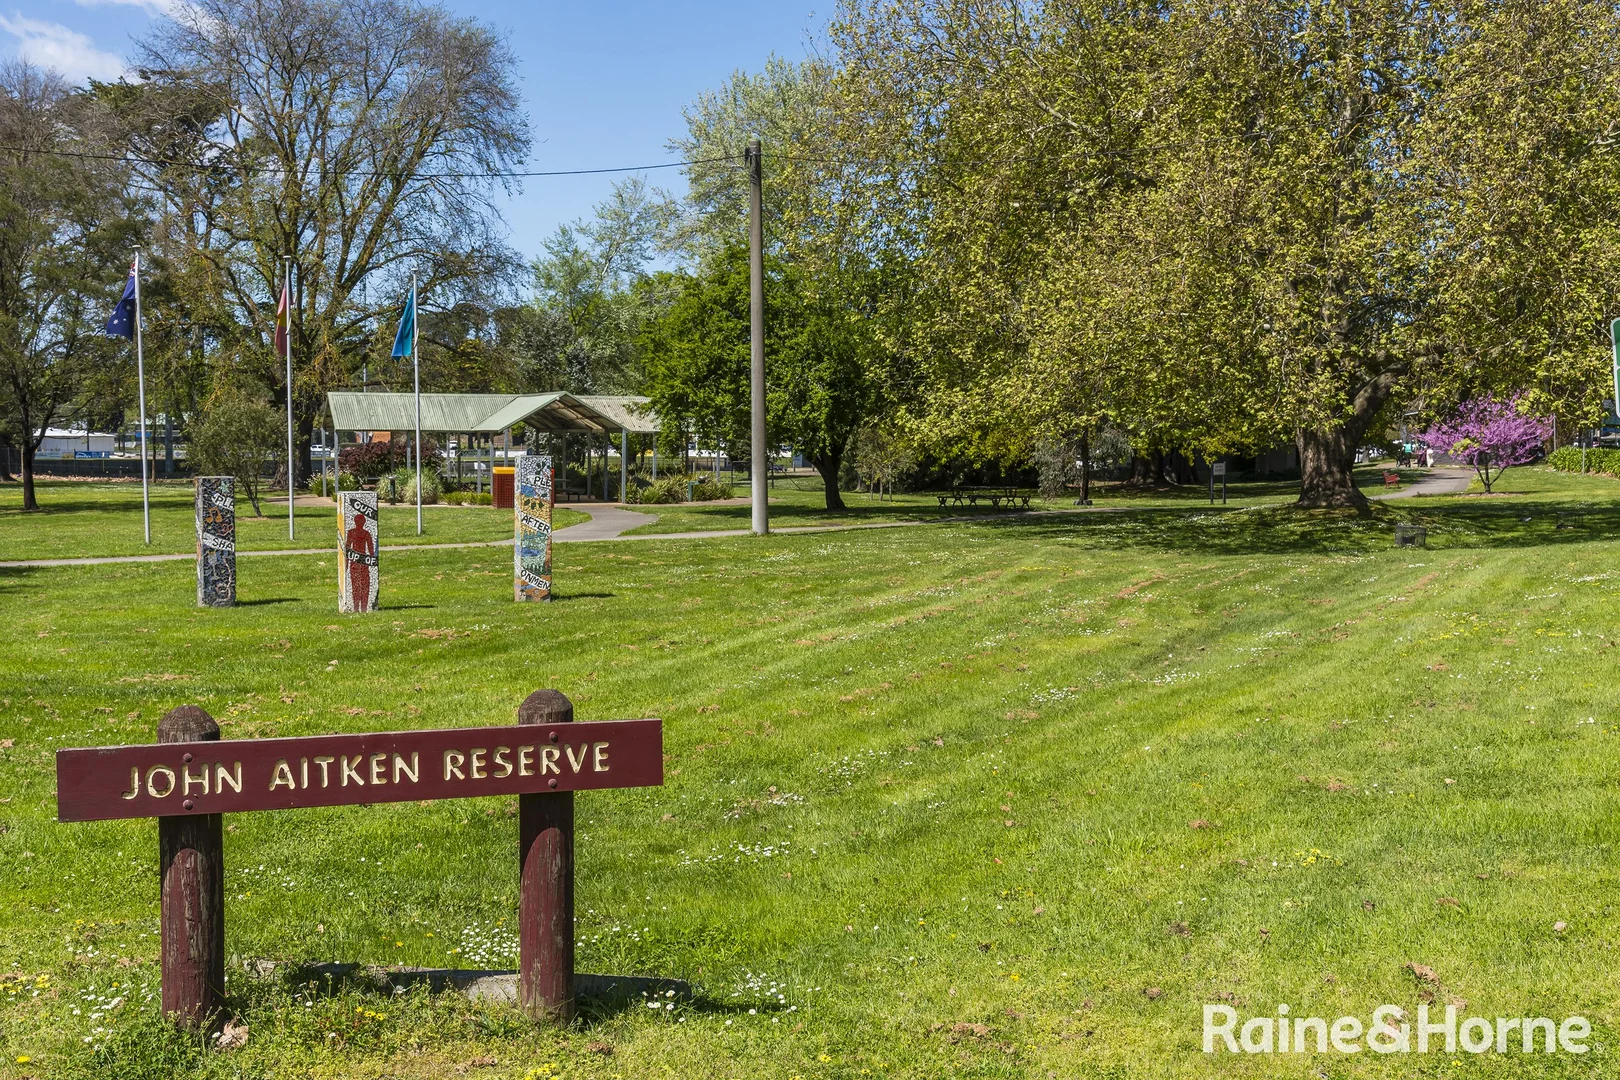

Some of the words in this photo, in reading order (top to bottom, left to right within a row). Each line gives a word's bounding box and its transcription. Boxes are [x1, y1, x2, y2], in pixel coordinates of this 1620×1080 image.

[354, 501, 373, 517] OUR
[522, 515, 550, 533] AFTER
[212, 538, 233, 551] SHA
[348, 551, 360, 562] UP
[365, 557, 376, 566] OF
[121, 760, 243, 800] JOHN
[268, 751, 419, 792] AITKEN
[443, 741, 610, 782] RESERVE
